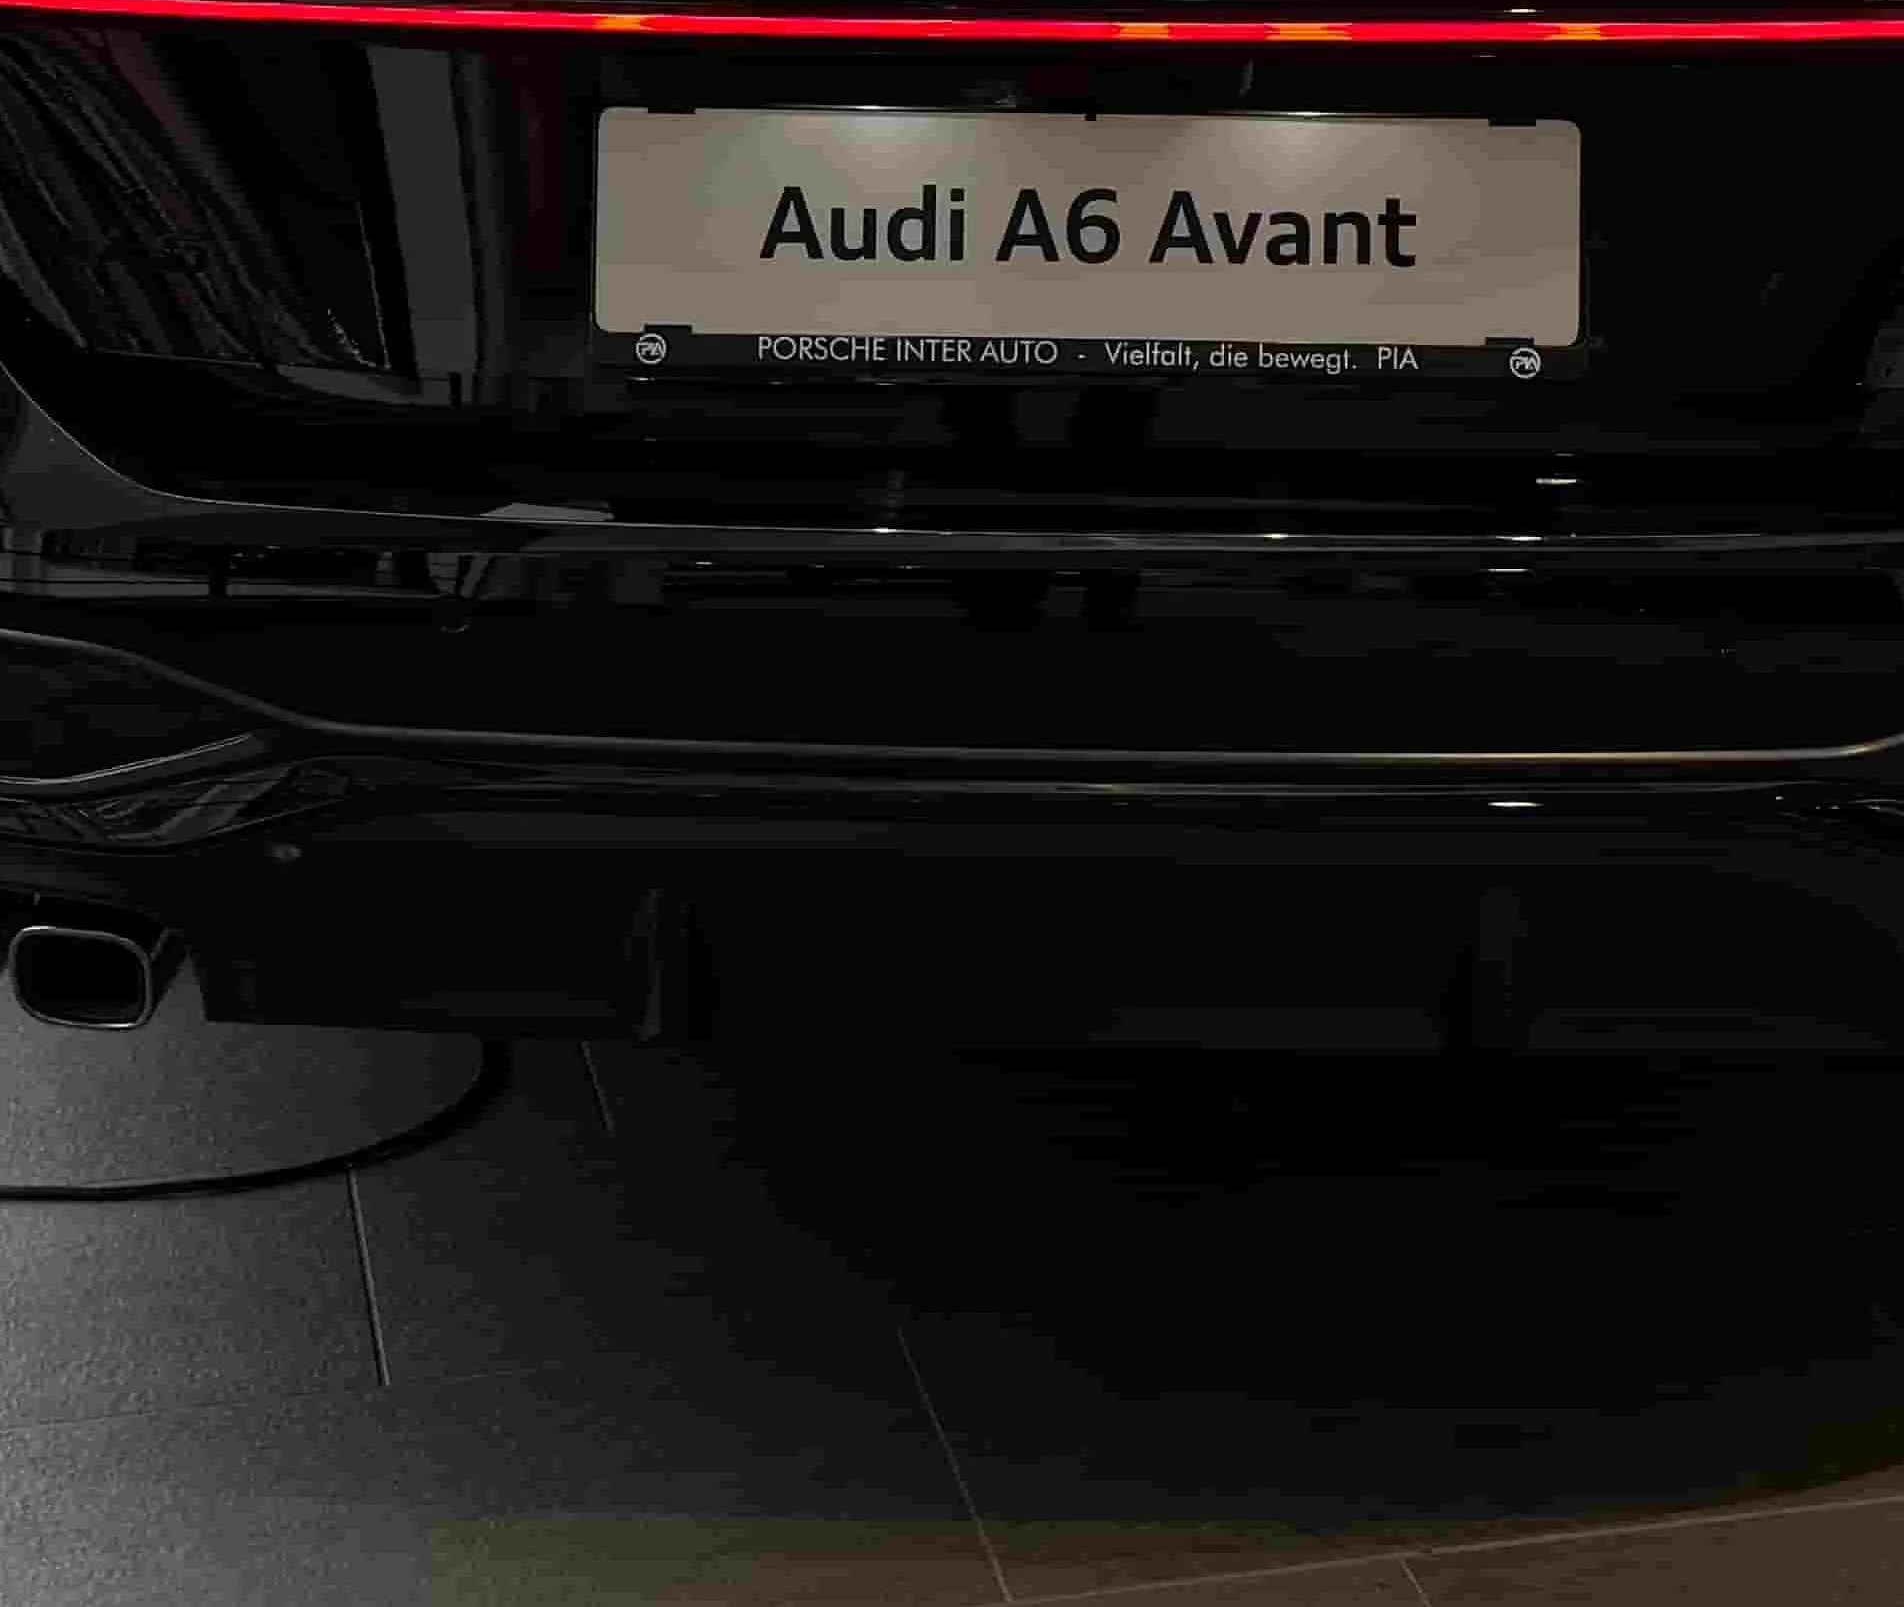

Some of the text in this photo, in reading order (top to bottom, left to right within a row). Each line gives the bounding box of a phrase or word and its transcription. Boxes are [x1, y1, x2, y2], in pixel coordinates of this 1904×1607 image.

[758, 184, 1417, 268] Audi A6 Avant
[757, 336, 889, 362] PORSCHE
[896, 337, 972, 363] INTER
[978, 339, 1059, 365] AUTO
[1104, 342, 1200, 370] Vielfalt,
[1208, 344, 1250, 369] die
[1257, 342, 1358, 375] bewegt.
[1377, 347, 1421, 371] PIA
